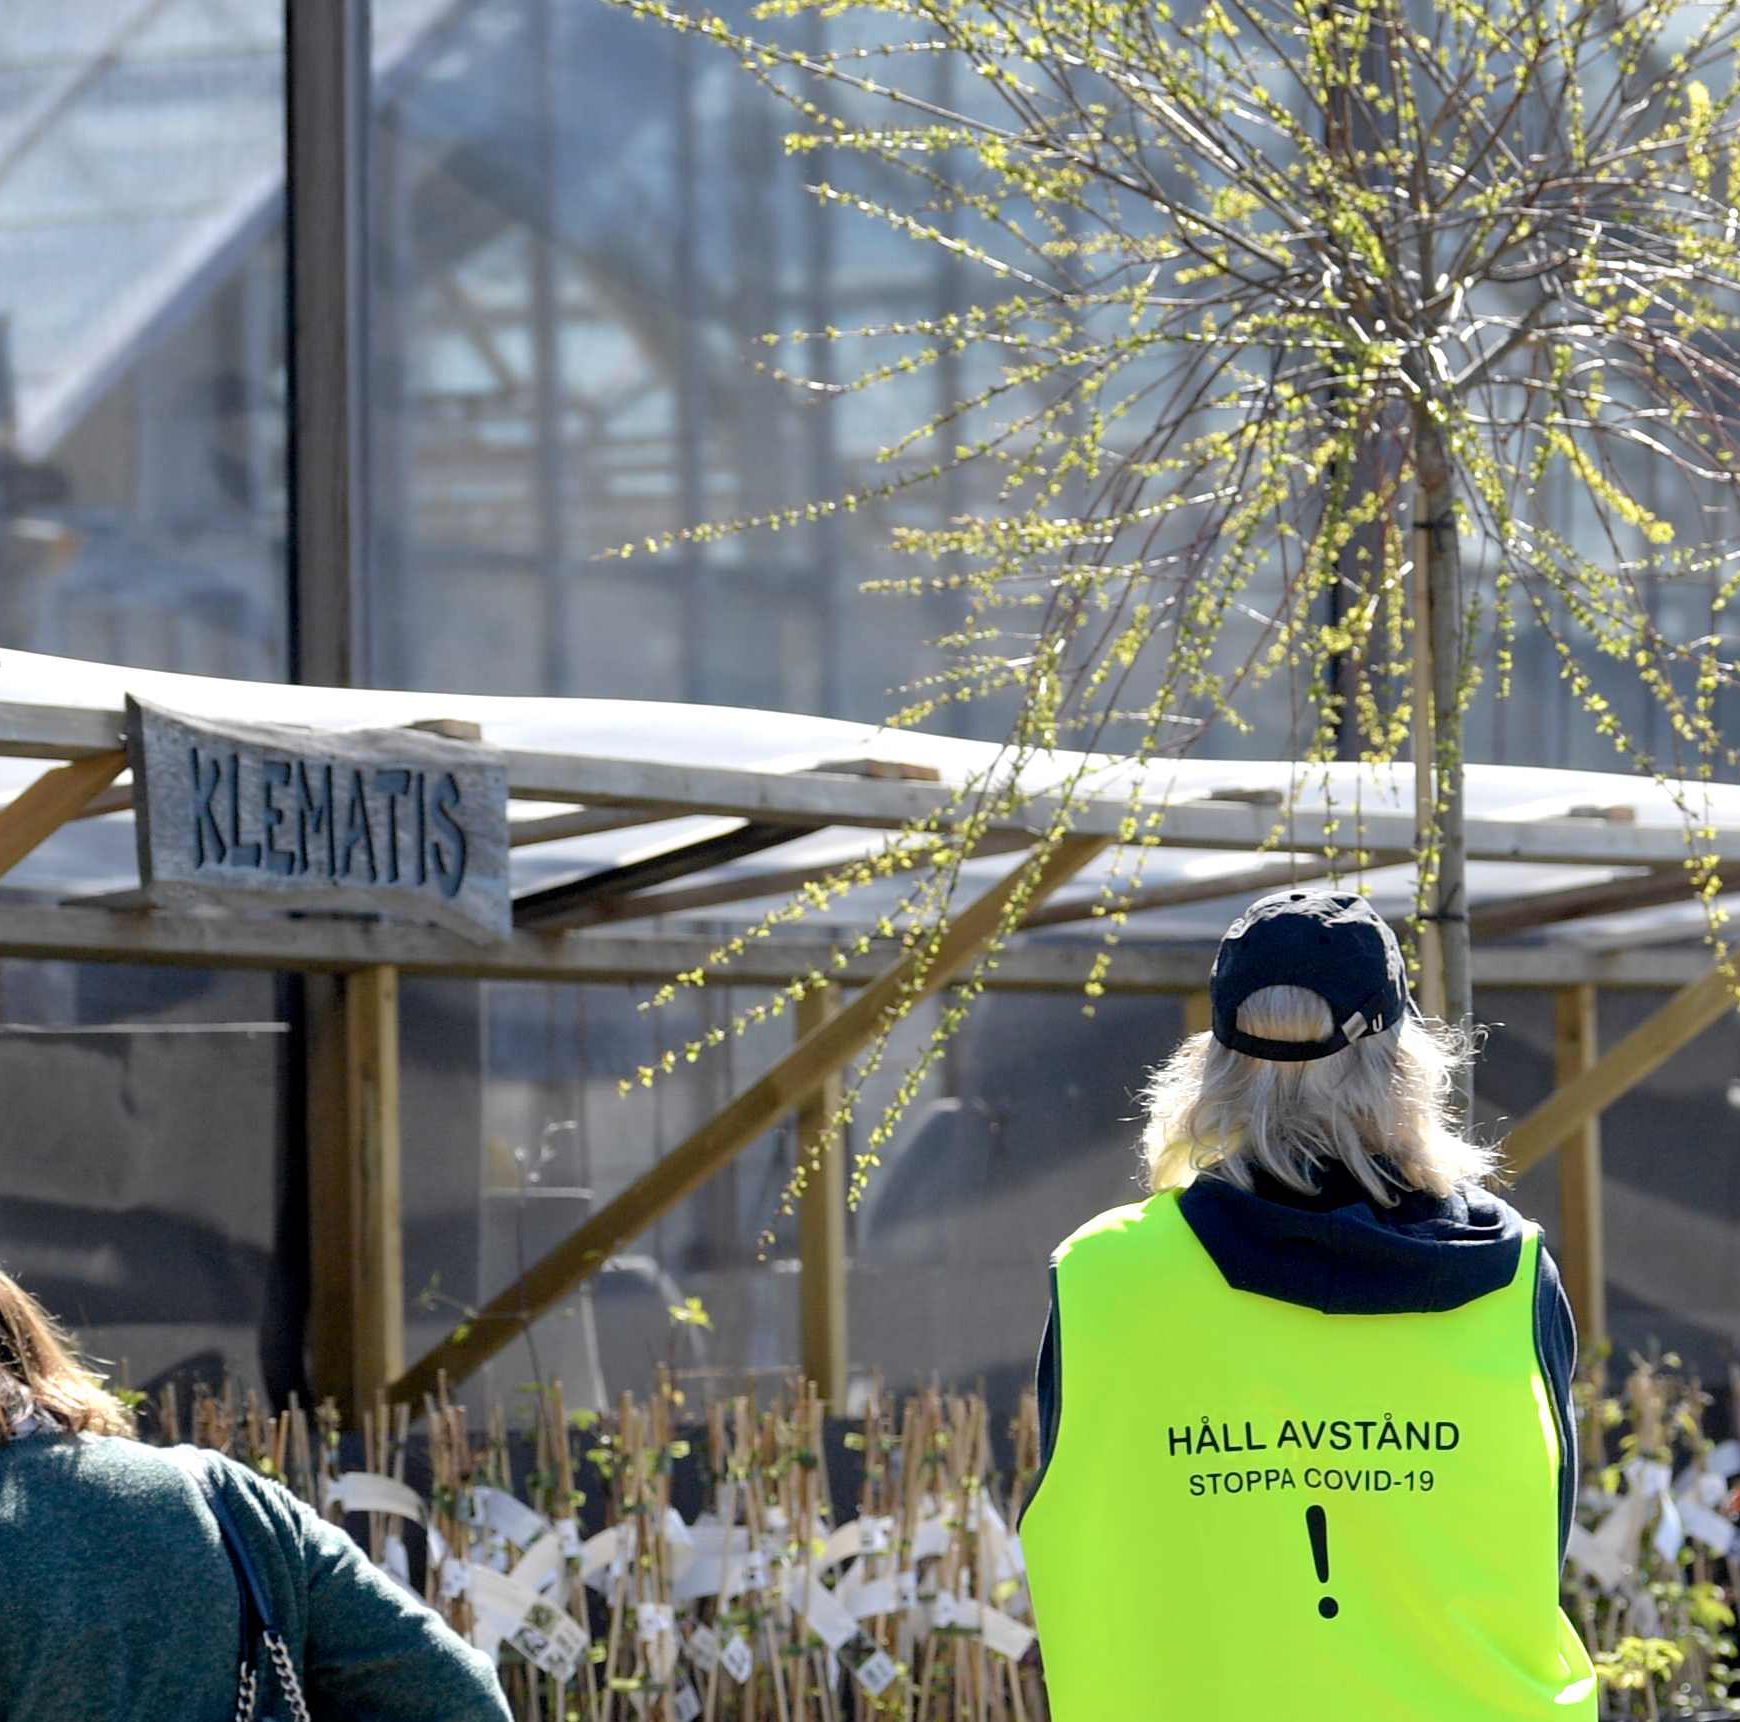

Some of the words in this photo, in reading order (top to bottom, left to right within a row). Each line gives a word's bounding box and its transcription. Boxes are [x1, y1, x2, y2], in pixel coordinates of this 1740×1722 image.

[191, 746, 468, 899] KLEMATIS
[1167, 1416, 1267, 1456] HÅLL
[1277, 1412, 1461, 1451] AVSTÅND
[1189, 1468, 1297, 1496] STOPPA
[1304, 1468, 1435, 1492] COVID-19
